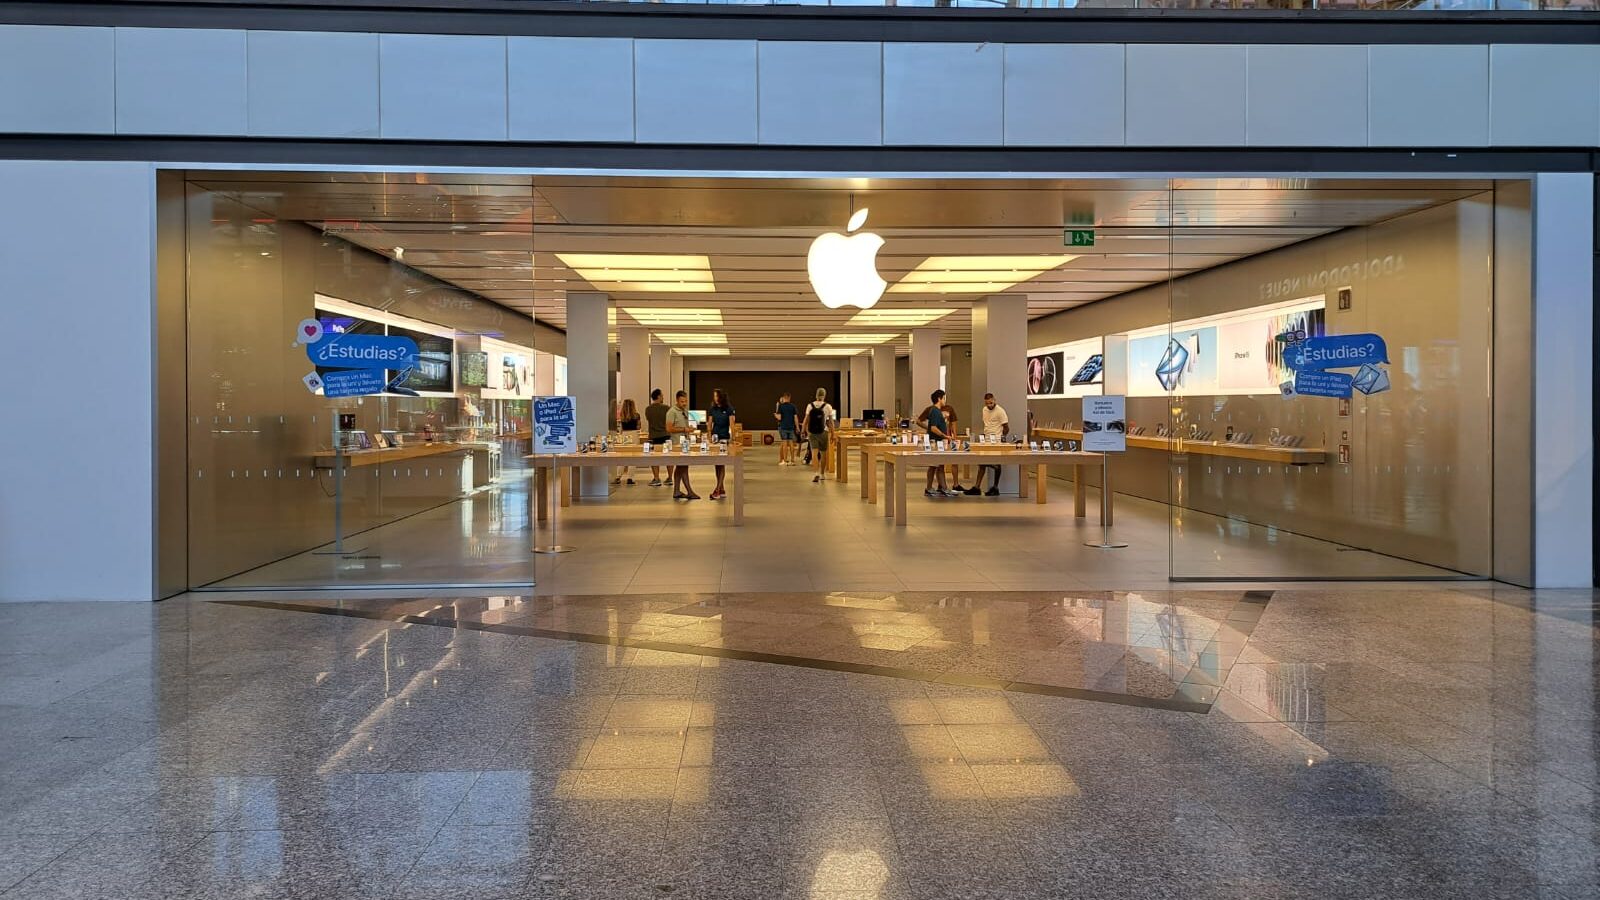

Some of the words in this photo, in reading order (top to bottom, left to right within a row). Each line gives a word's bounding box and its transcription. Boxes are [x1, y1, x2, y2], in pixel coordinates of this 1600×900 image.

[319, 343, 407, 361] ¿Estudias?
[1295, 343, 1376, 365] ¿Estudias?
[326, 374, 351, 382] Compra
